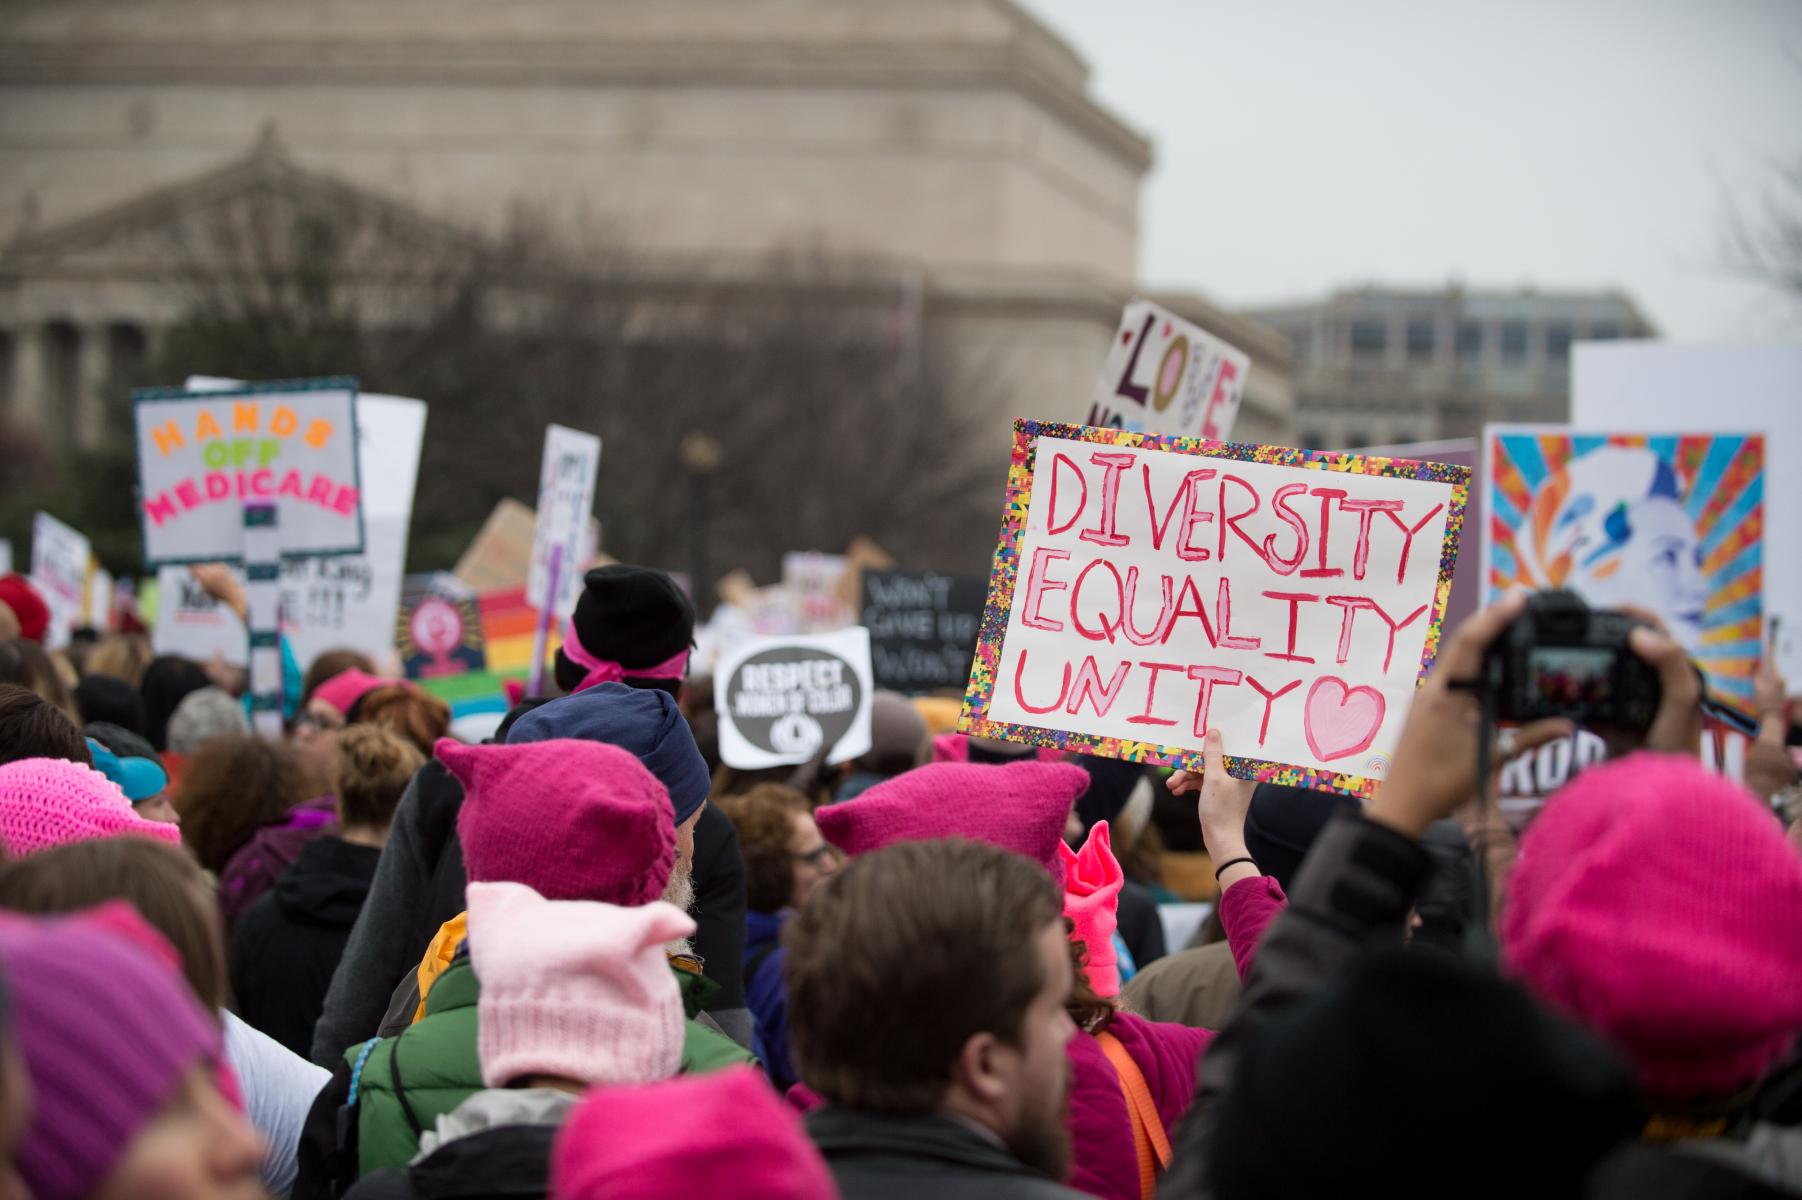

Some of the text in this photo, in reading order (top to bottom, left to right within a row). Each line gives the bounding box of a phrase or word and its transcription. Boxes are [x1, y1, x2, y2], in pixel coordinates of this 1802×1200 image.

[152, 400, 335, 457] HANDS
[203, 439, 281, 469] OFF
[144, 468, 360, 527] MEDICARE
[1047, 453, 1443, 584] DIVERSITY
[1021, 546, 1428, 674] EQUALITY
[741, 659, 843, 691] RESPECT
[1014, 649, 1303, 747] UNITY
